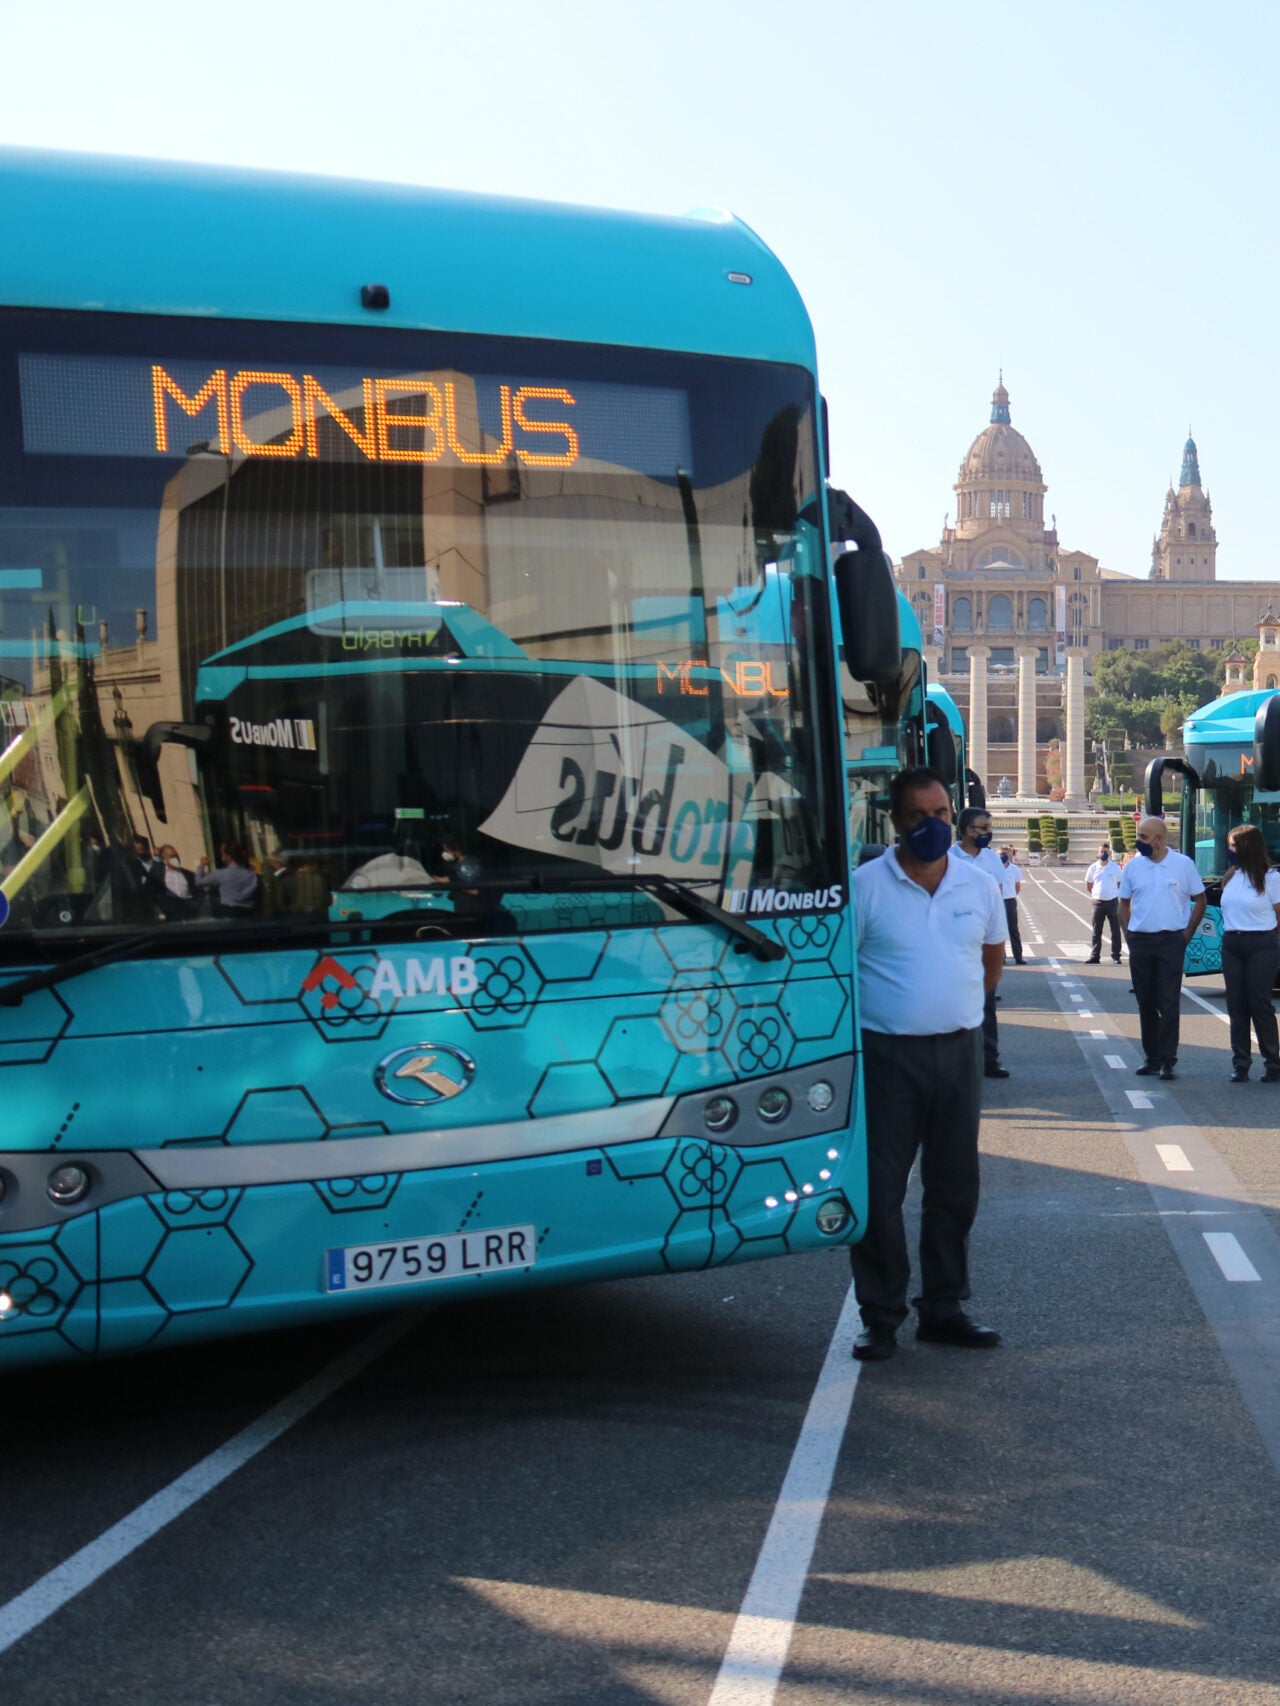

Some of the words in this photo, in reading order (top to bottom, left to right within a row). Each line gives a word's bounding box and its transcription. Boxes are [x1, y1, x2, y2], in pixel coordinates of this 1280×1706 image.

[152, 365, 578, 466] MONBUS
[750, 885, 843, 911] MONBUS
[369, 957, 479, 999] AMB
[333, 1274, 341, 1284] E
[353, 1242, 447, 1283] 9759
[462, 1231, 526, 1270] LRR
